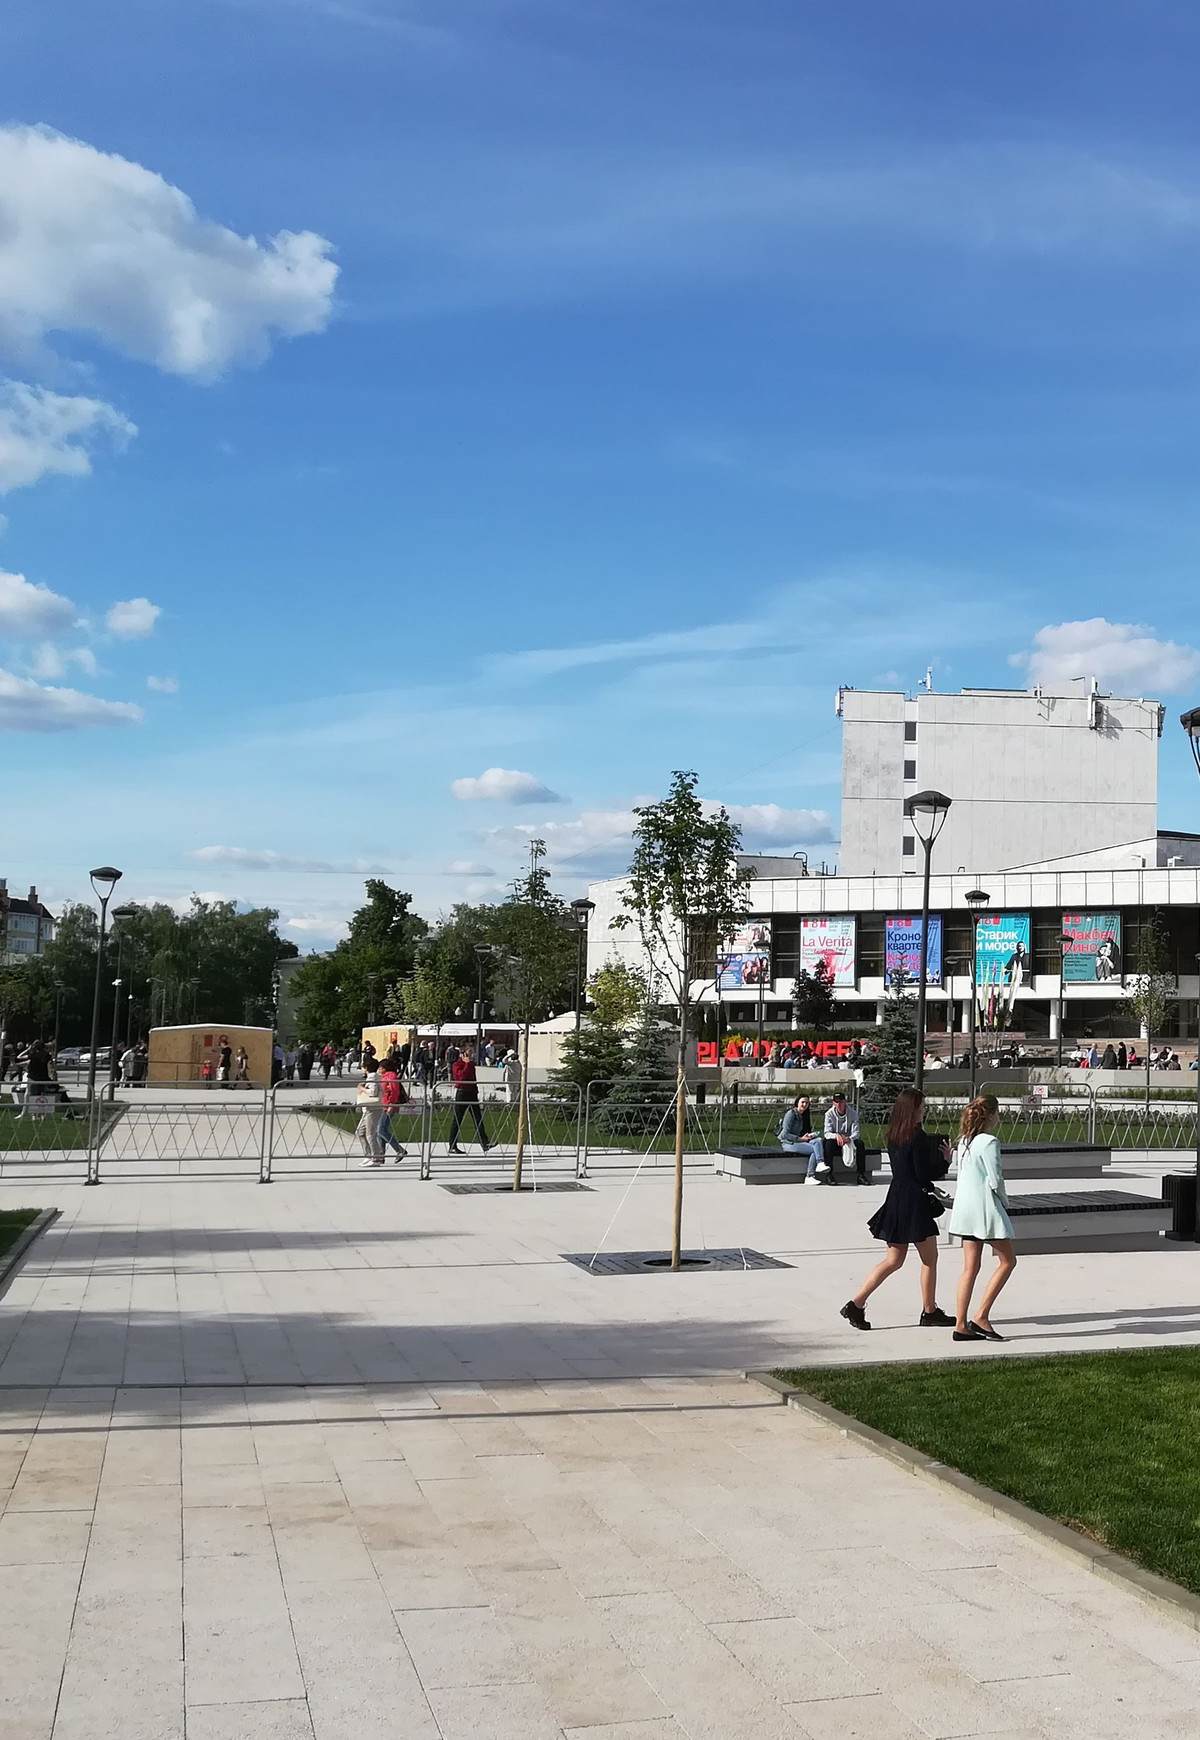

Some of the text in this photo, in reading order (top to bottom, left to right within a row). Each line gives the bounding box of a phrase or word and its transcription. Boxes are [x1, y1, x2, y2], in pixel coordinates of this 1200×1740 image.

[887, 931, 922, 941] Кроно
[976, 929, 1019, 942] Старик
[802, 936, 815, 947] La
[887, 942, 922, 951] кварте
[976, 942, 1017, 953] и море
